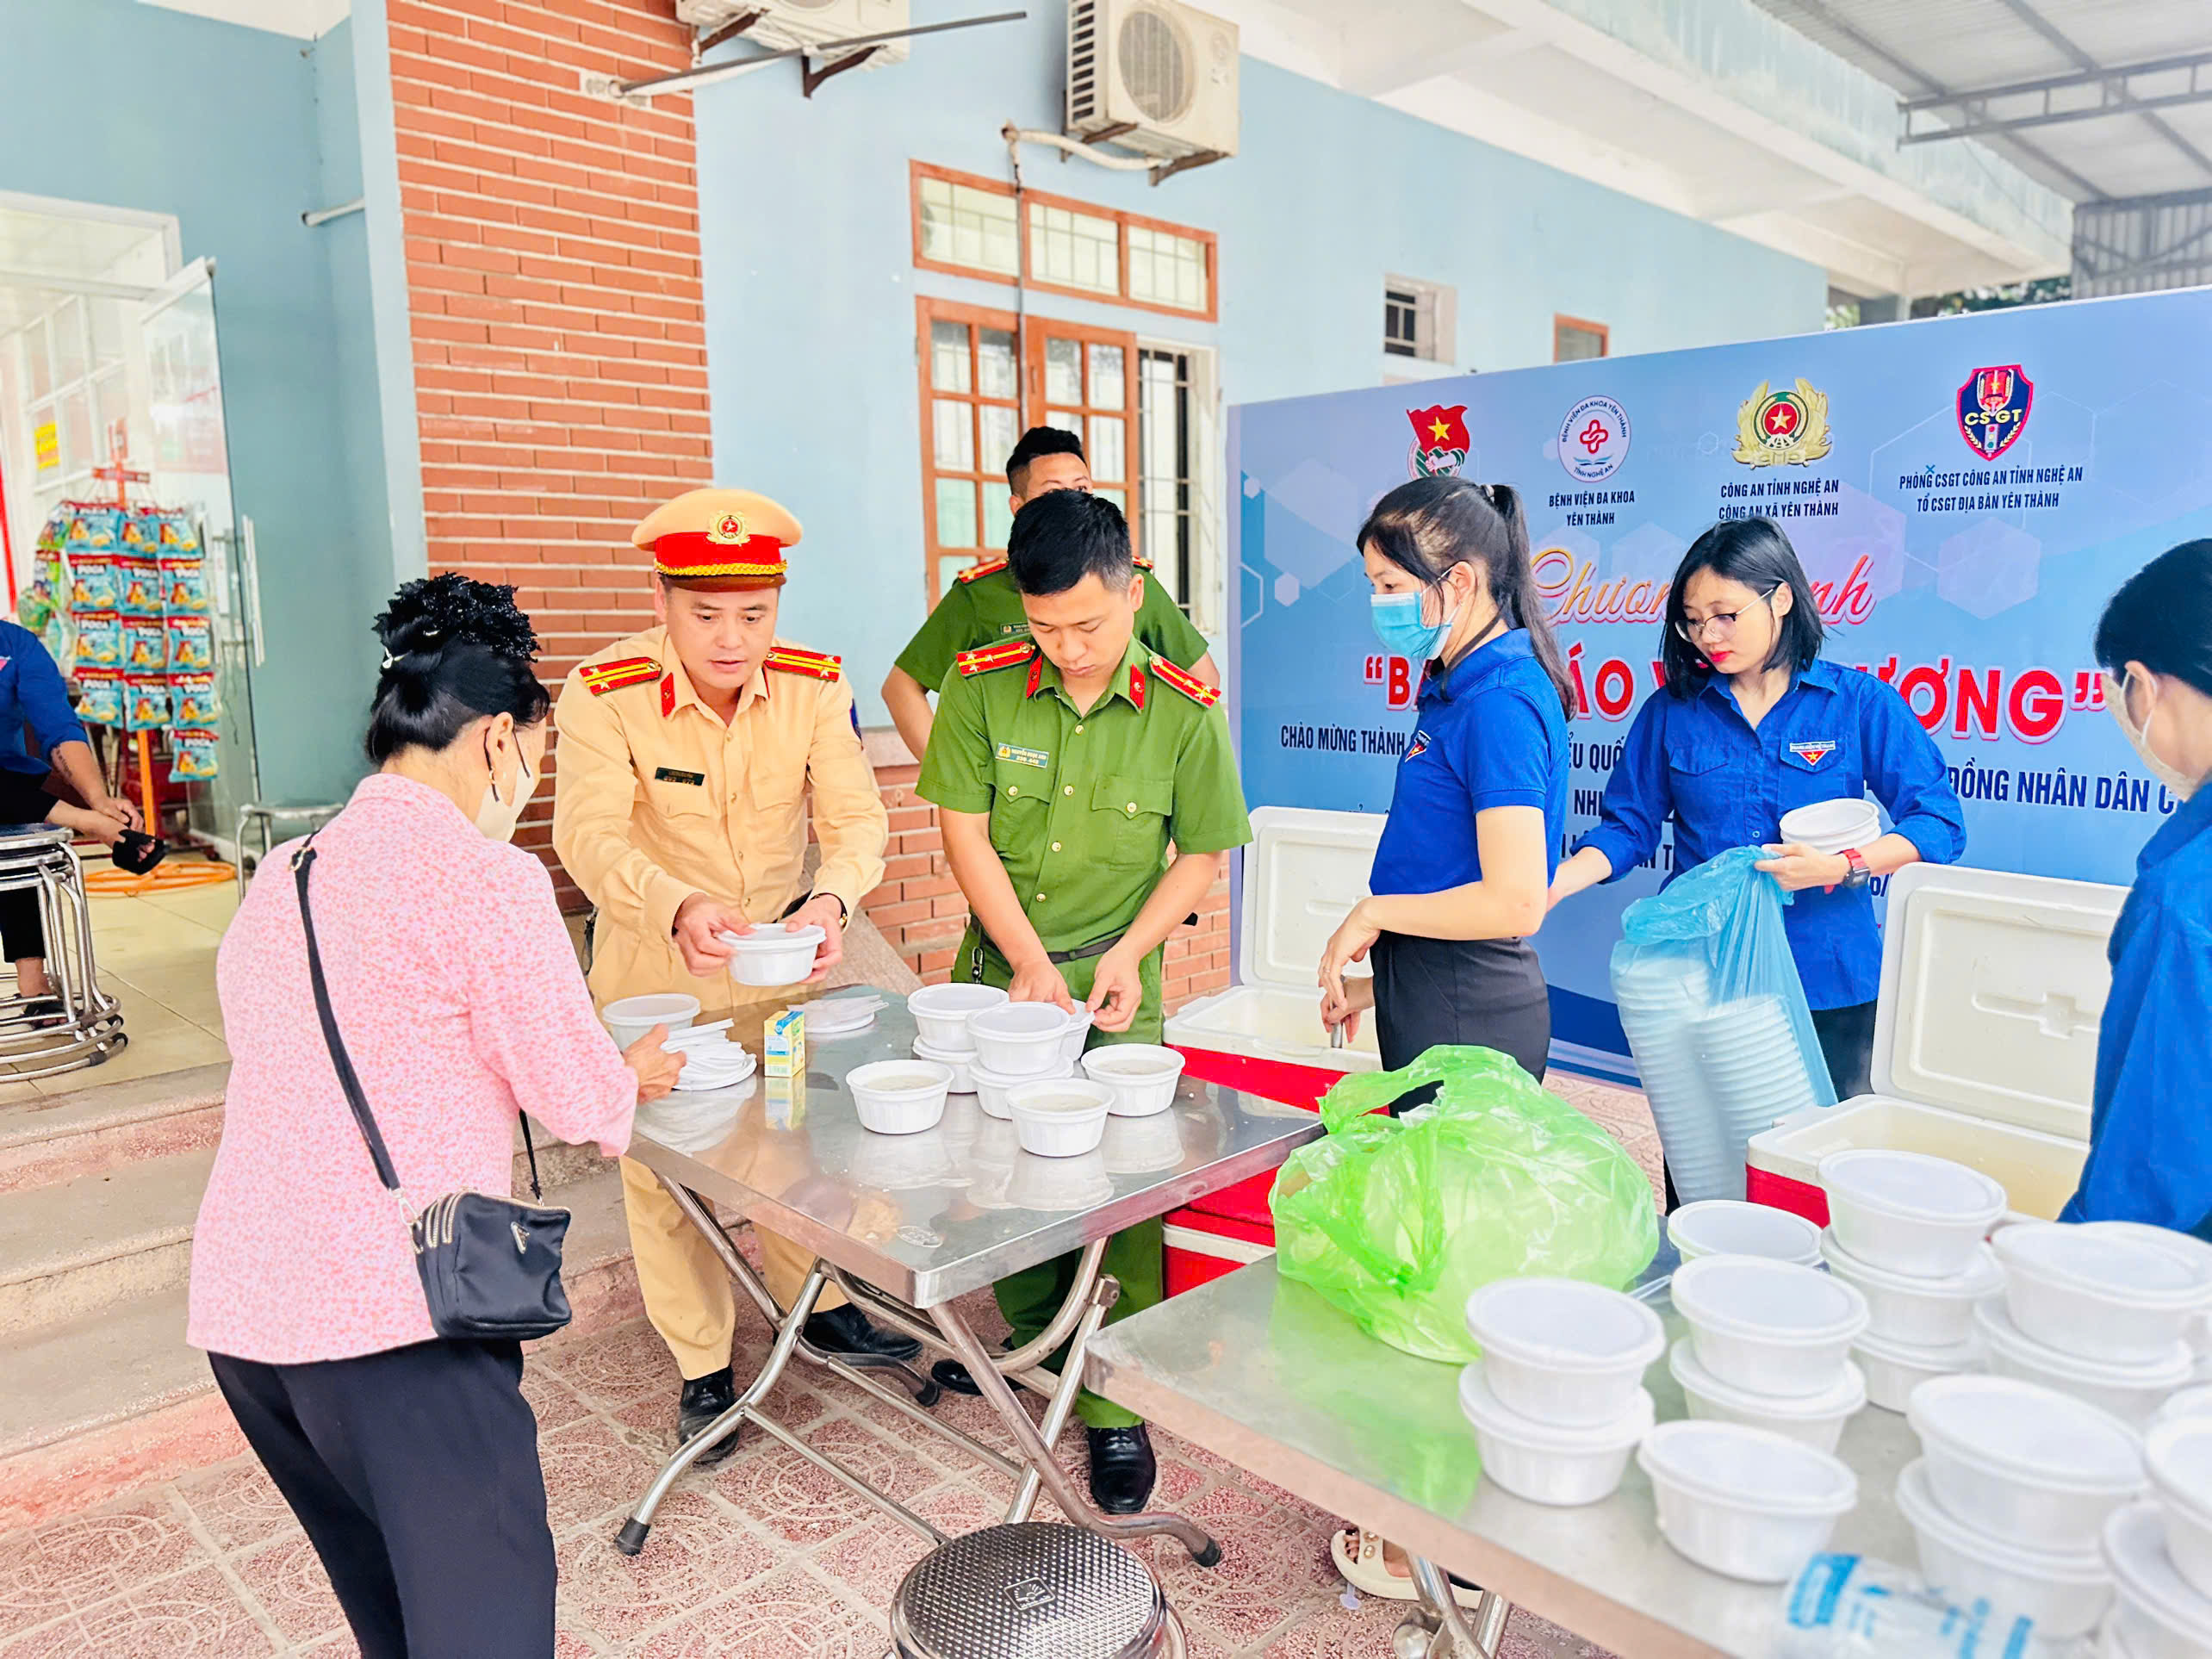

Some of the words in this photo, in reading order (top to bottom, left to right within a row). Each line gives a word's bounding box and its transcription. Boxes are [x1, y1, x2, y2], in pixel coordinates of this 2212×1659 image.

[1964, 408, 2022, 426] CSGT
[1899, 472, 1933, 489] PHÒNG
[1935, 472, 1961, 488] CSGT
[1962, 469, 1990, 487] CÔNG
[1992, 470, 2007, 485] AN
[2010, 465, 2034, 484] TỈNH
[2036, 464, 2066, 487] NGHỆ
[2067, 466, 2083, 482] AN
[1720, 482, 1748, 498] CÔNG
[1749, 482, 1765, 496] AN
[1767, 478, 1791, 496] TỈNH
[1793, 477, 1821, 497] NGHỆ
[1824, 479, 1839, 494] AN
[1549, 492, 1572, 509] BỆNH
[1574, 490, 1594, 508] VIỆN
[1596, 491, 1608, 504] ĐA
[1611, 490, 1635, 504] KHOA
[1917, 493, 1929, 512] TỔ
[1931, 496, 1957, 512] CSGT
[1958, 495, 1975, 513] ĐỊA
[1978, 493, 1999, 509] BÀN
[2002, 491, 2022, 508] YÊN
[2024, 490, 2060, 507] THÀNH
[1566, 512, 1583, 526] YÊN
[1585, 510, 1615, 525] THÀNH
[1718, 504, 1746, 520] CÔNG
[1765, 502, 1779, 518] XÃ
[1781, 501, 1801, 517] YÊN
[1804, 500, 1839, 516] THÀNH
[1281, 721, 1314, 749] CHÀO
[1318, 724, 1357, 752] MỪNG
[1360, 726, 1406, 755] THÀNH
[2016, 767, 2087, 807] NHÂN
[2095, 771, 2150, 812] DÂN
